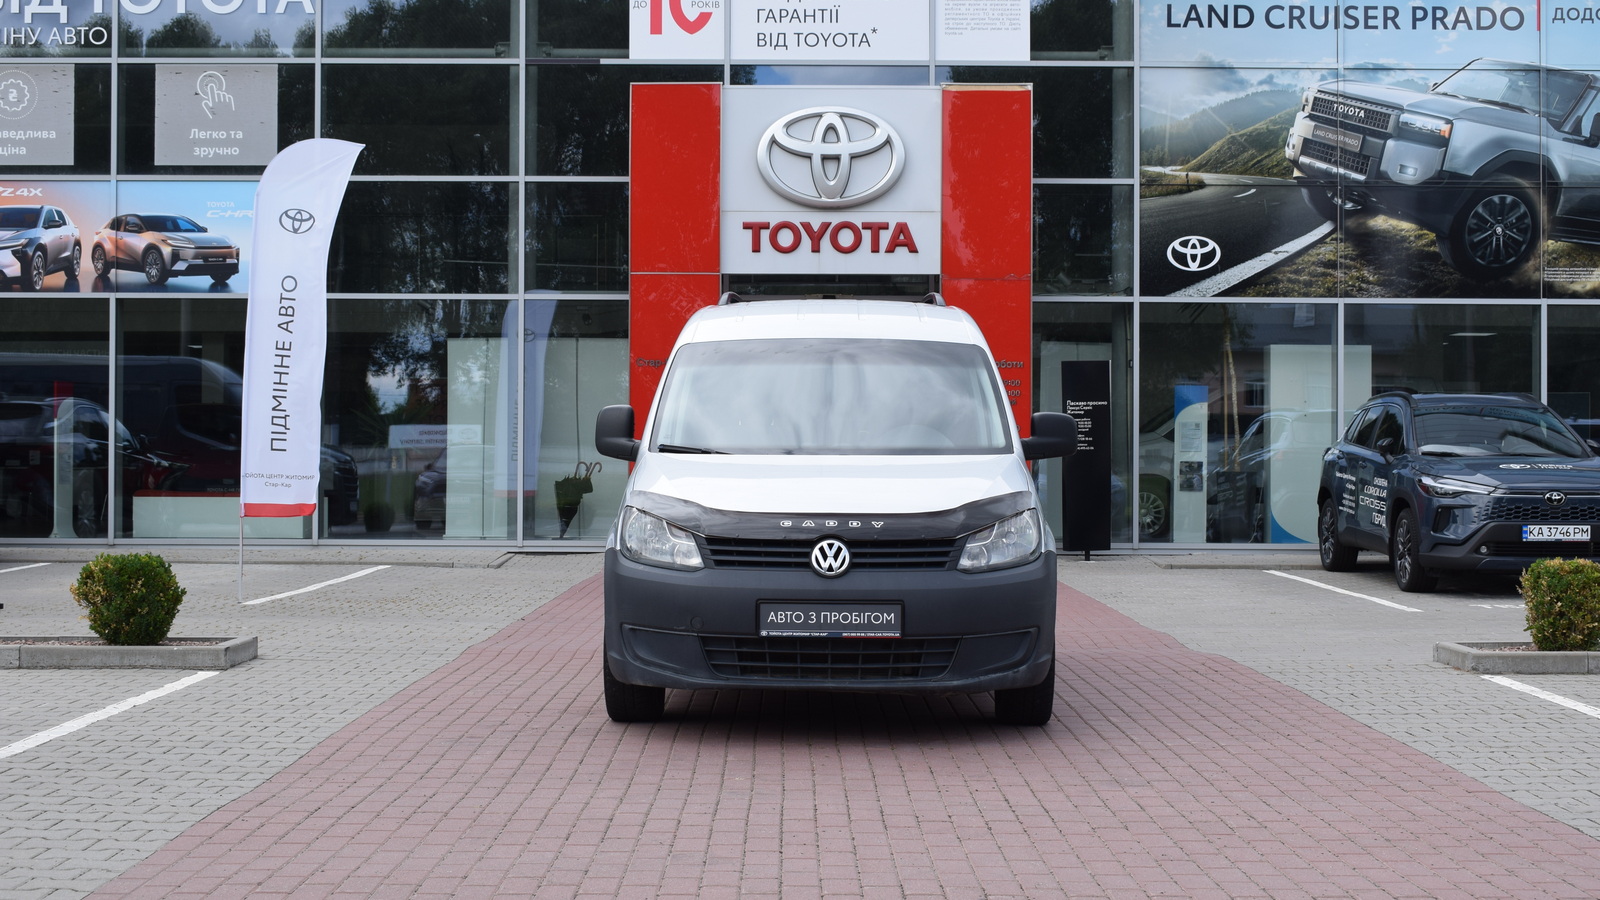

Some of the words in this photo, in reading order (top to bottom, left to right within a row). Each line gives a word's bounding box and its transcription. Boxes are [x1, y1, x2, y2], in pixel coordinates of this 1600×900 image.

[756, 5, 840, 24] ГАРАНТІЇ
[1166, 4, 1255, 29] LAND
[1264, 5, 1401, 30] CRUISER
[1411, 6, 1525, 31] PRADO
[47, 26, 108, 45] АВТО
[756, 32, 788, 50] ВІД
[1333, 104, 1365, 118] TOYOTA
[189, 129, 227, 139] Легко
[230, 130, 243, 139] та
[1313, 129, 1325, 137] LAND
[193, 146, 240, 158] зручно
[0, 187, 43, 197] Z4X
[742, 220, 919, 254] TOYOTA
[277, 275, 298, 334] АВТО
[995, 359, 1024, 368] оботи
[1003, 379, 1021, 387] 9:00
[270, 340, 292, 452] ПІДМІННЕ
[1364, 485, 1387, 498] COROLLA
[1359, 495, 1387, 511] CROSS
[780, 520, 884, 528] CADDY
[1528, 527, 1544, 537] KA
[1546, 527, 1571, 537] 3746
[1573, 527, 1589, 537] PM
[767, 611, 804, 624] АВТО
[820, 611, 895, 624] ПРОБІГОМ
